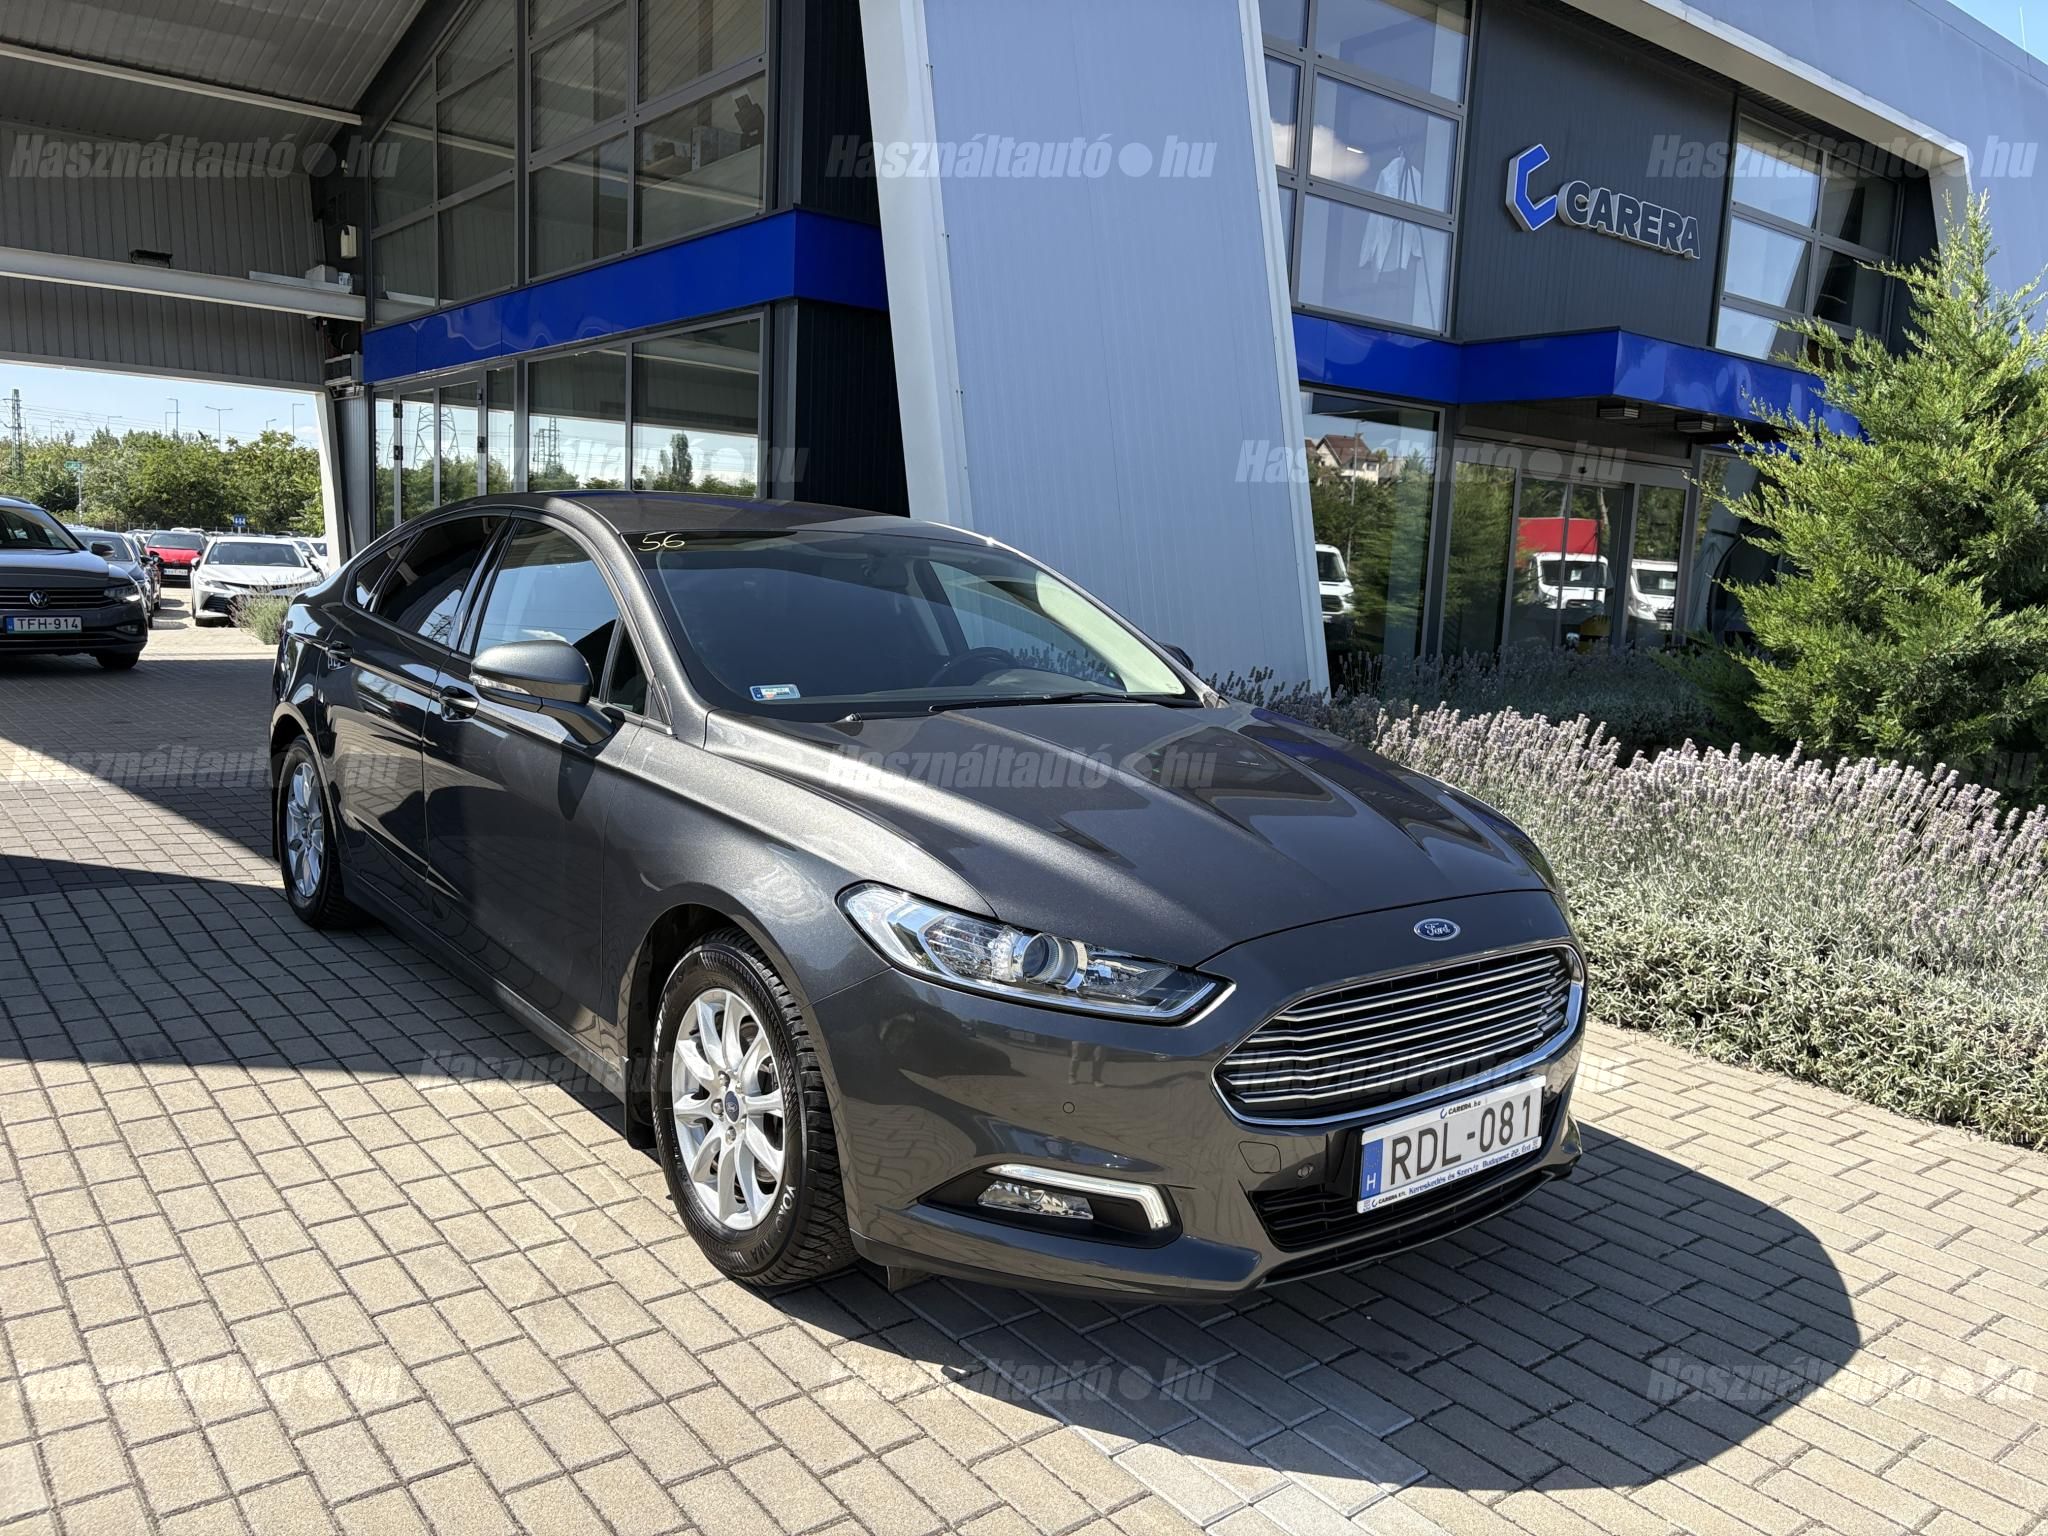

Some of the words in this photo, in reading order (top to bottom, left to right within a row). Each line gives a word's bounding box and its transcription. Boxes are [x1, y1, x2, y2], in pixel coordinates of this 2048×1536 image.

[1559, 180, 1700, 260] CARERA
[638, 531, 685, 551] 56
[17, 618, 79, 630] TFH-914
[1424, 922, 1451, 936] Ford
[1366, 1172, 1377, 1192] H
[1390, 1095, 1532, 1186] RDL-081
[1482, 1152, 1510, 1169] Budapest
